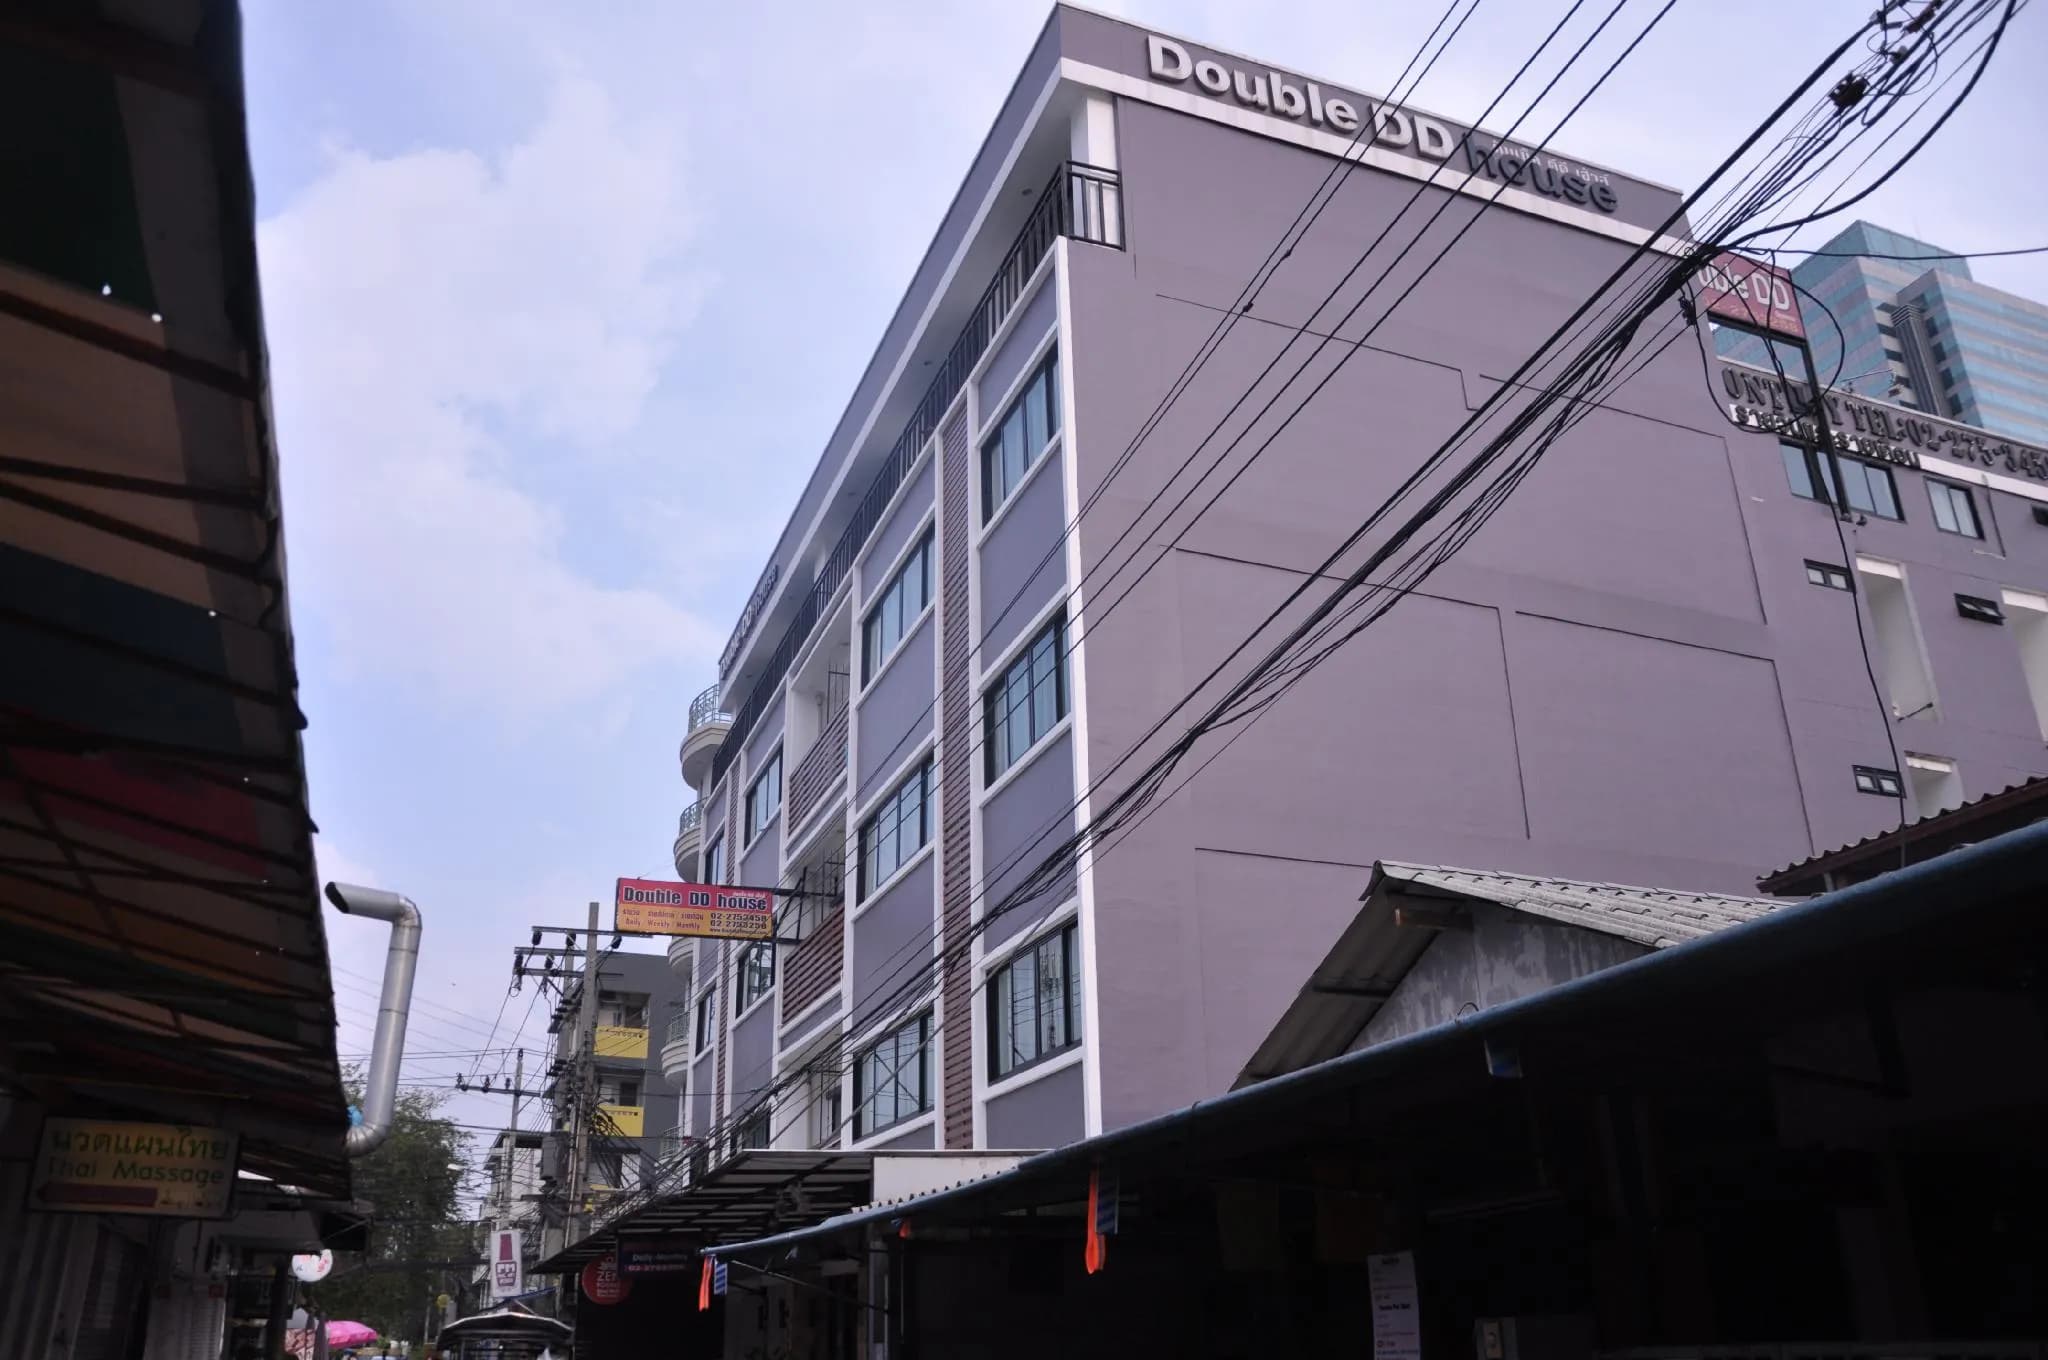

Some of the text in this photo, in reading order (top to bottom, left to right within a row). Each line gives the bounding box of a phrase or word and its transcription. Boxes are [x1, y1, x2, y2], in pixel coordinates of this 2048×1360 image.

[1147, 34, 1619, 213] Double DD house
[1751, 272, 1790, 311] DD
[623, 886, 681, 905] Double
[689, 890, 710, 907] DD
[717, 893, 768, 911] house
[51, 1125, 229, 1161] นวดแผนไทย
[48, 1156, 226, 1188] Thai Massage
